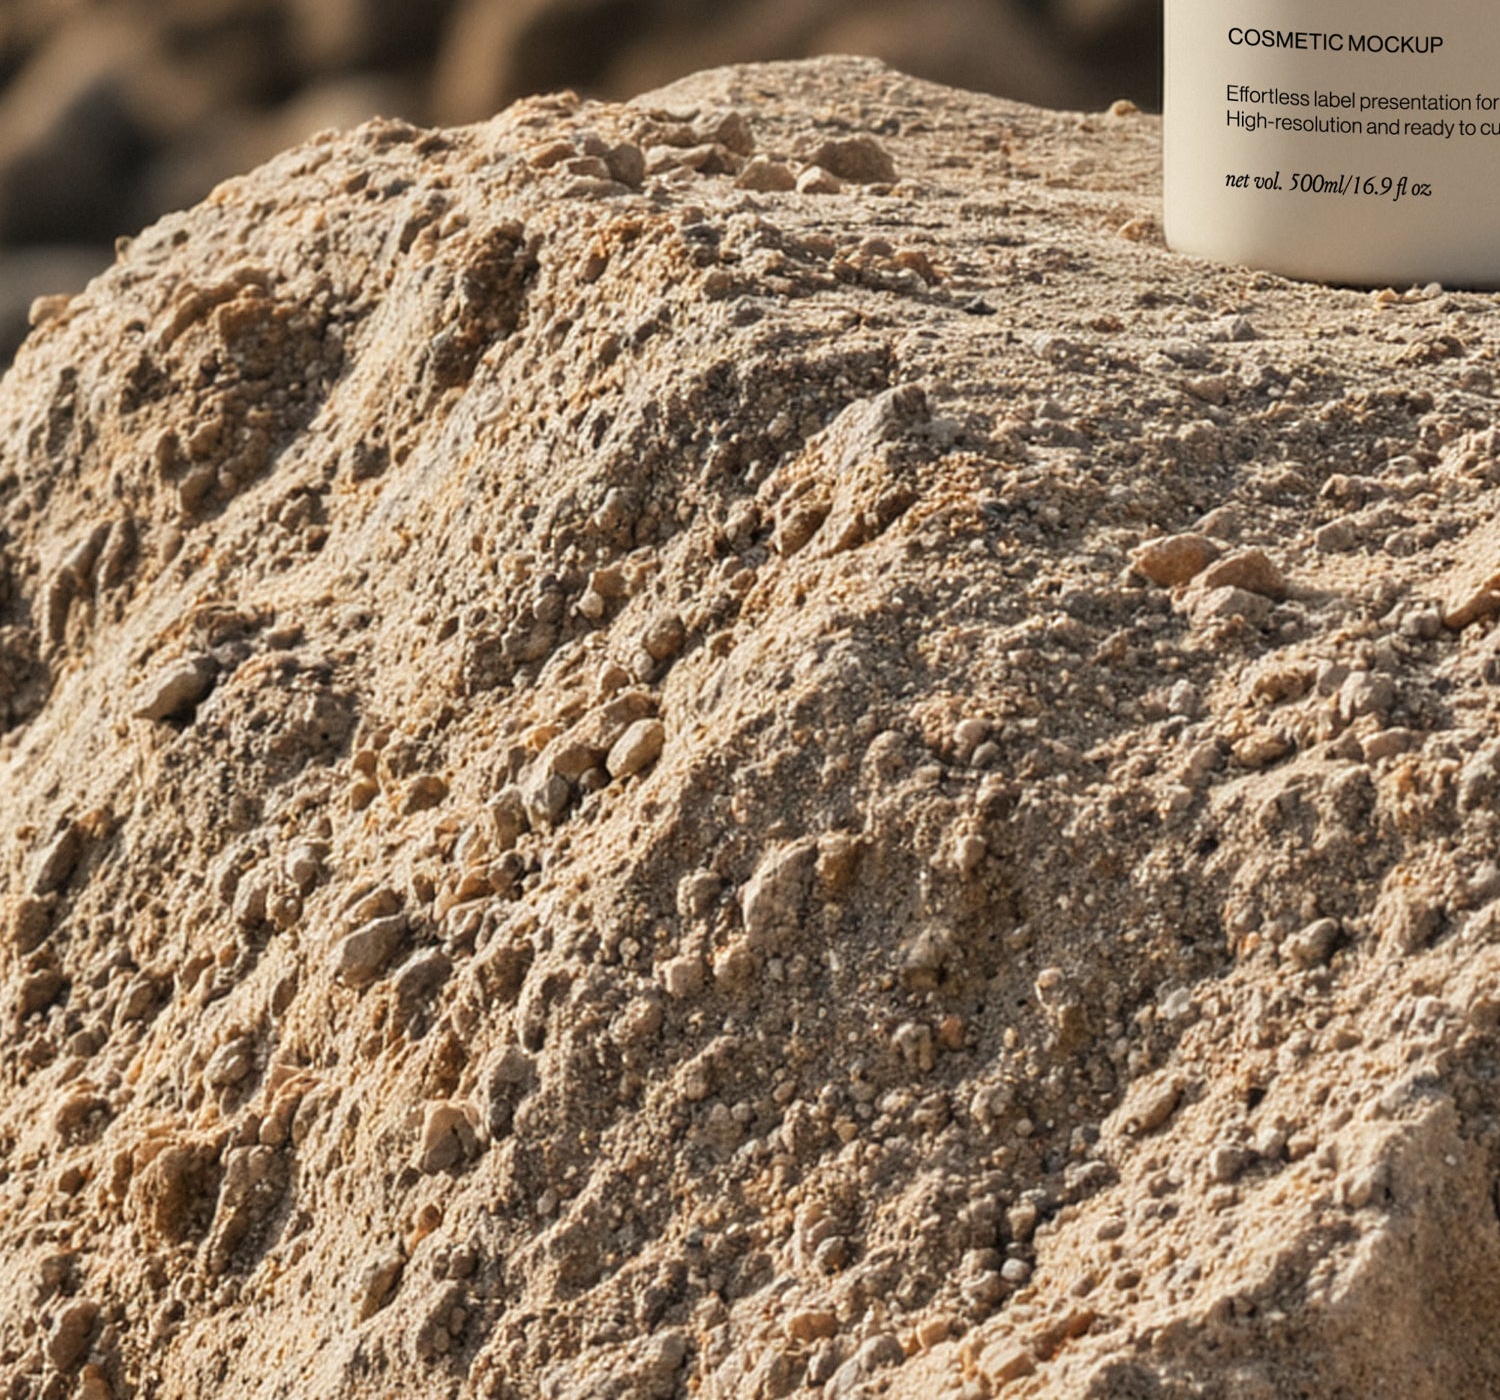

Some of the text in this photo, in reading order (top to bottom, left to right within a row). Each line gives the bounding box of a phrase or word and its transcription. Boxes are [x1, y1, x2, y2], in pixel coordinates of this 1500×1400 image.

[1227, 26, 1444, 54] COSMETIC MOCKUP
[1226, 84, 1310, 107] Effortless
[1313, 89, 1356, 109] label
[1359, 93, 1473, 112] presentation
[1475, 93, 1500, 111] for
[1226, 110, 1363, 135] High-resolution
[1366, 117, 1401, 136] and
[1404, 118, 1455, 139] ready
[1457, 119, 1478, 136] to
[1225, 171, 1433, 202] net vol. 500ml/16.9 fl oz
